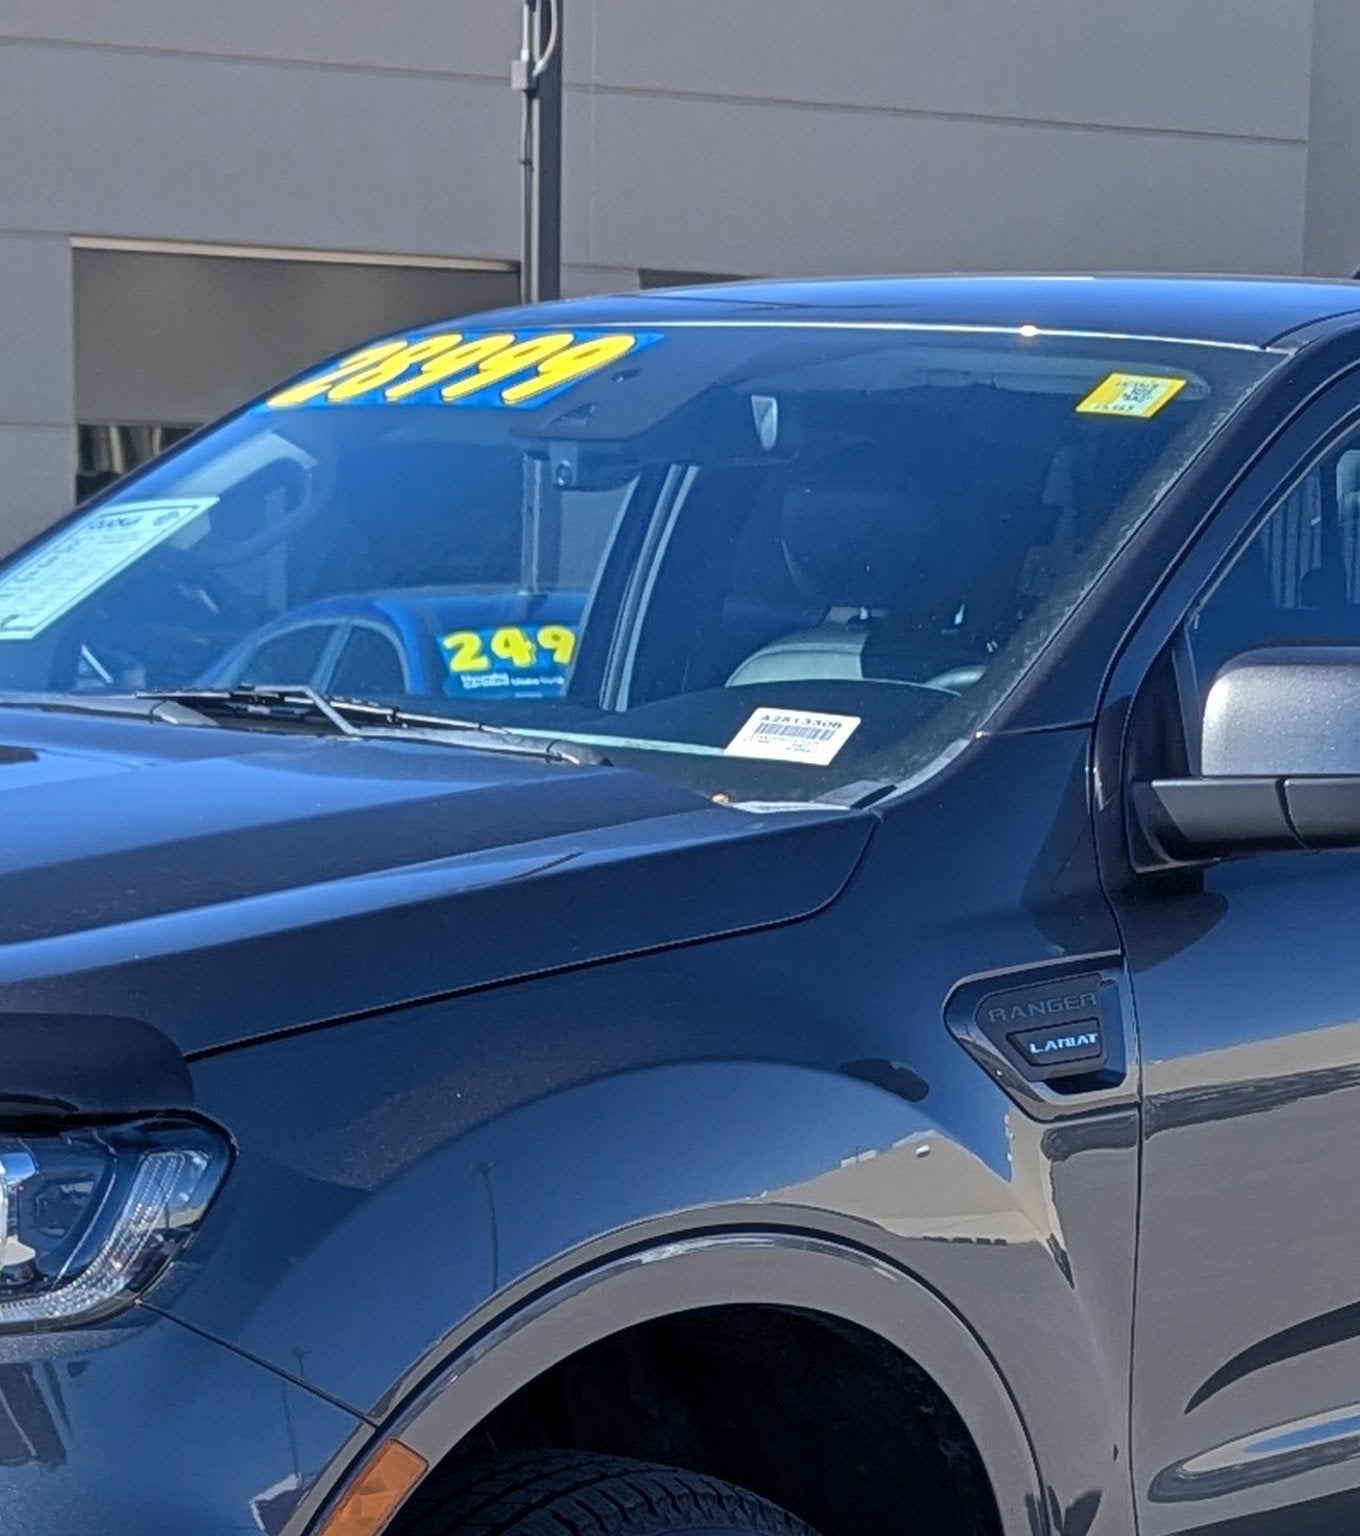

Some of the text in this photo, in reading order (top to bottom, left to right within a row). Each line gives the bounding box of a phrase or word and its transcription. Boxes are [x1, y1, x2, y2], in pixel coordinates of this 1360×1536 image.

[267, 333, 637, 408] 28999
[988, 992, 1098, 1023] RANGER
[1029, 1033, 1099, 1054] LARIAT
